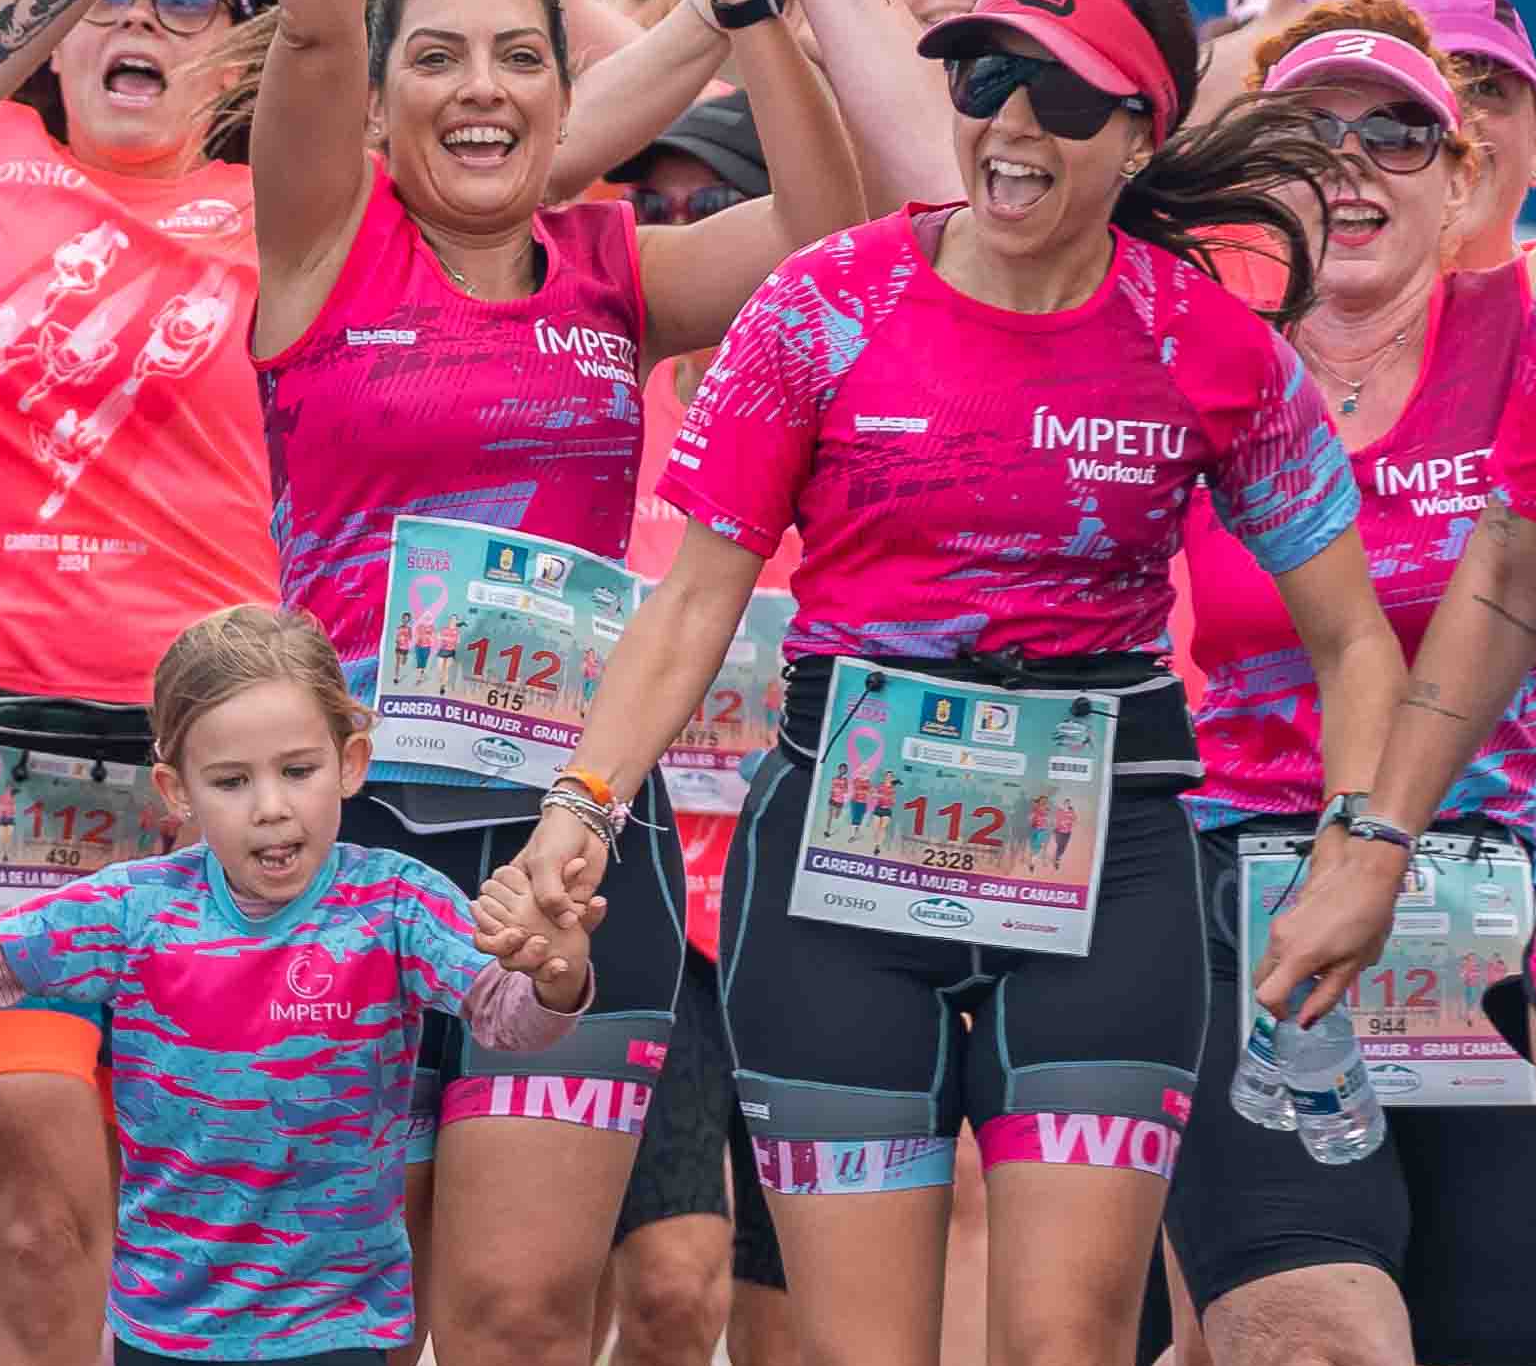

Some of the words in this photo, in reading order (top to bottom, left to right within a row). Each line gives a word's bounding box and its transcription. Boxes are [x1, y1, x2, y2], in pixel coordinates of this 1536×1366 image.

[1031, 405, 1188, 461] ÍMPETU
[1066, 458, 1157, 486] Workout
[407, 556, 451, 572] SUMA
[467, 637, 561, 692] 112
[487, 689, 524, 711] 615
[383, 700, 442, 718] CARRERA
[445, 706, 462, 721] DE
[463, 709, 480, 723] LA
[479, 712, 521, 734] MUJER
[532, 724, 568, 744] GRAN
[396, 735, 446, 750] OYSHO
[24, 800, 116, 845] 112
[903, 795, 1007, 847] 112
[45, 849, 81, 866] 430
[922, 848, 974, 871] 2328
[8, 871, 25, 884] DE
[812, 854, 876, 878] CARRERA
[878, 865, 898, 882] DE
[900, 869, 918, 886] LA
[920, 873, 969, 892] MUJER
[979, 882, 1017, 898] GRAN
[1019, 887, 1079, 905] CANARIA
[823, 892, 876, 912] OYSHO
[1369, 1018, 1407, 1036] 944
[1364, 1042, 1411, 1058] MUJER
[1422, 1043, 1460, 1056] GRAN
